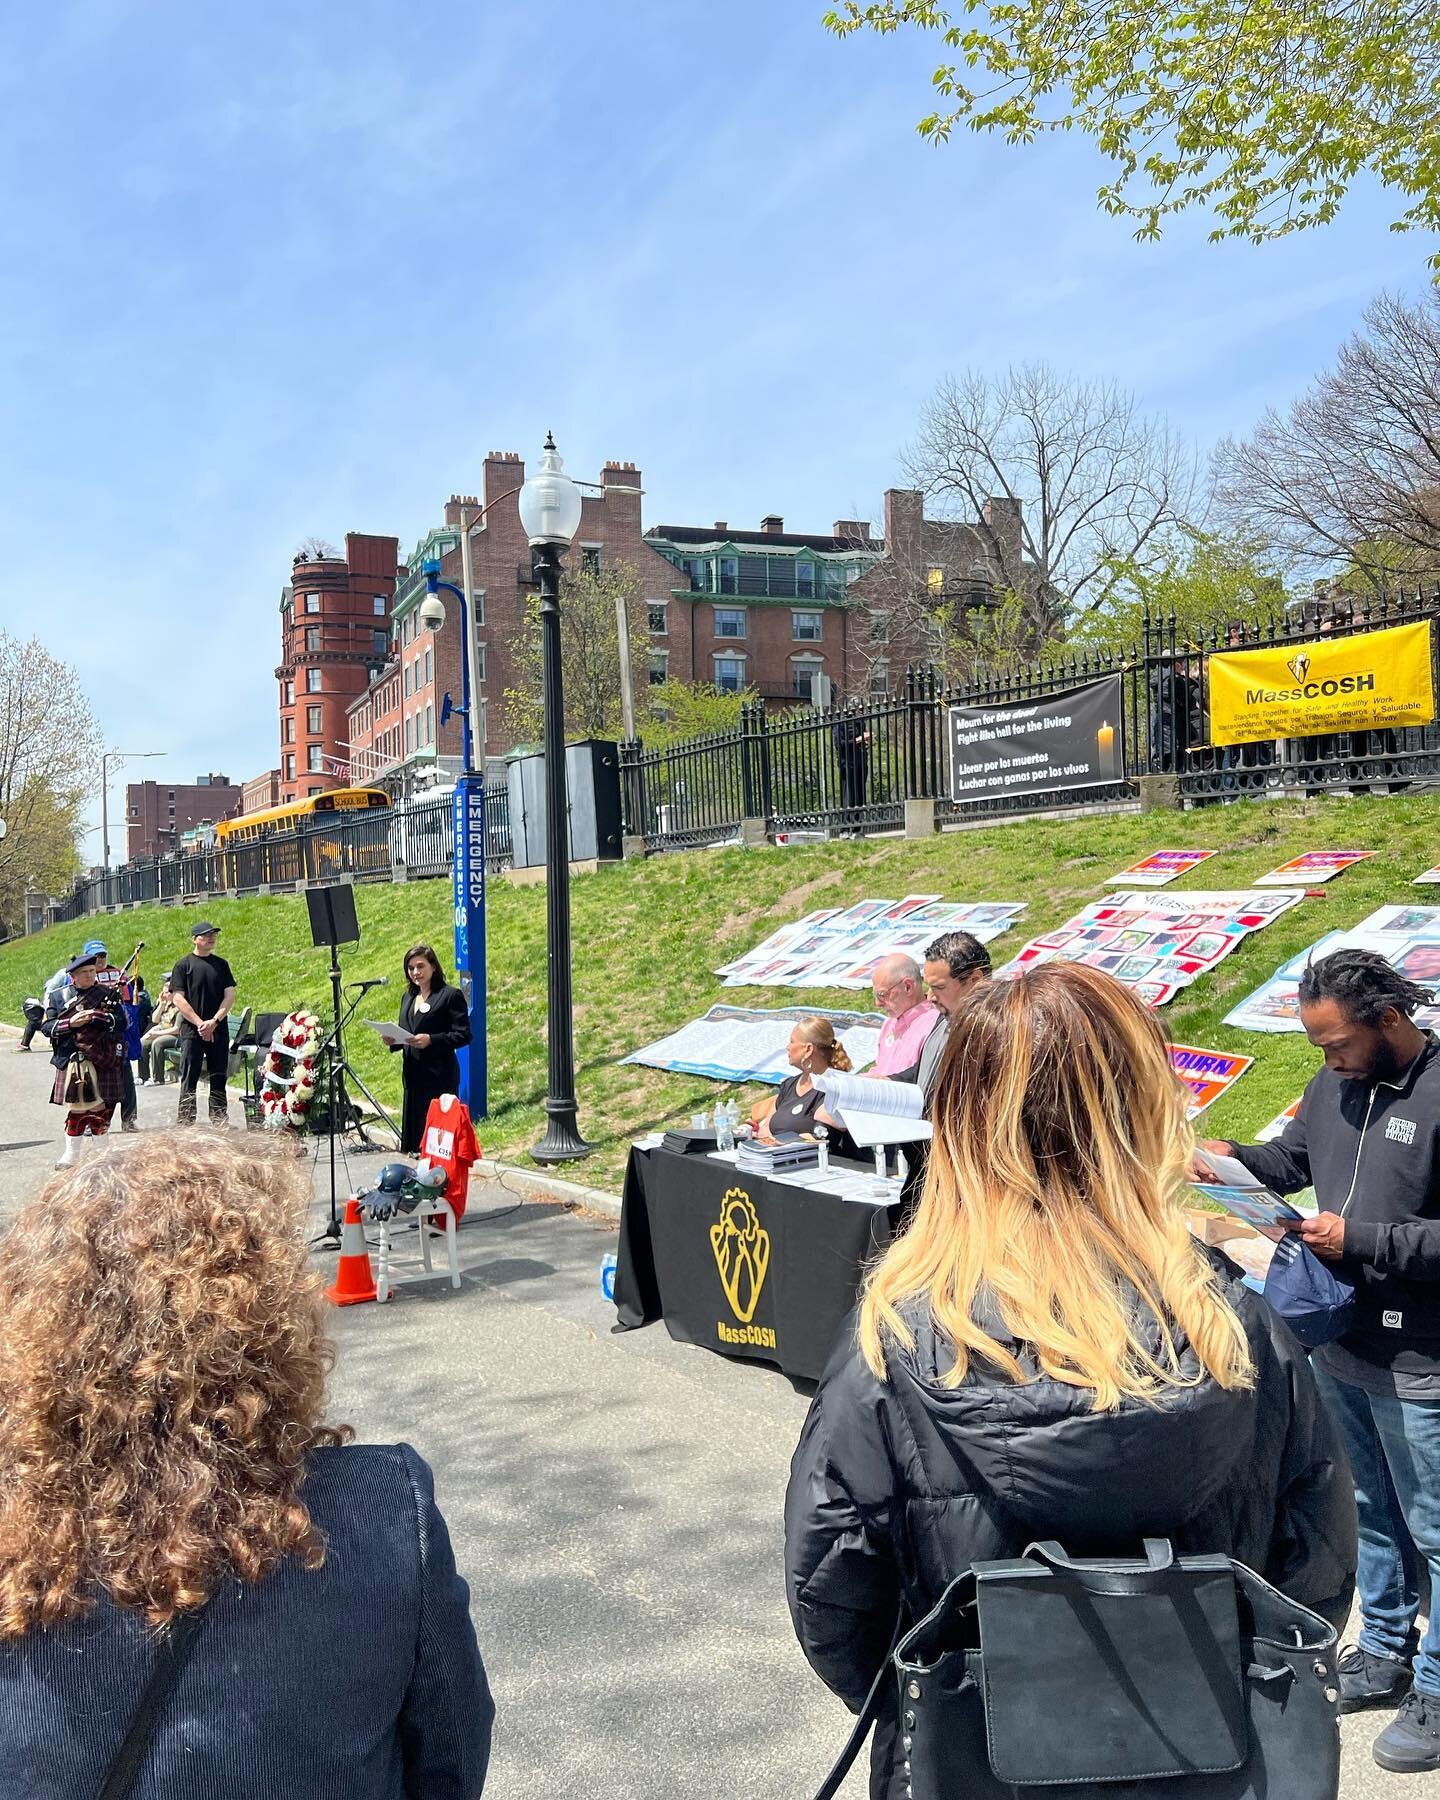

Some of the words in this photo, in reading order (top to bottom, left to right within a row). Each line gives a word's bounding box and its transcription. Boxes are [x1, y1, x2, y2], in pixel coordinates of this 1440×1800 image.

[1246, 673, 1374, 705] MassCOSH
[956, 718, 982, 730] Mourn
[982, 713, 996, 726] for
[996, 711, 1012, 722] the
[1234, 711, 1259, 721] Standing
[1262, 708, 1289, 718] Together
[1342, 699, 1368, 708] Healthy
[1305, 713, 1334, 722] Trabajos
[1337, 709, 1368, 720] Seguros
[1381, 702, 1424, 713] Saludable.
[1355, 716, 1369, 724] nan
[957, 731, 979, 746] Fight
[979, 729, 996, 742] like
[996, 725, 1012, 738] hell
[1012, 722, 1026, 735] for
[1027, 720, 1042, 732] the
[1043, 715, 1072, 729] living
[959, 762, 983, 775] Llorar
[984, 760, 999, 773] por
[1000, 757, 1011, 769] los
[1012, 752, 1049, 766] muertos
[959, 777, 987, 790] Luchar
[987, 775, 1004, 786] con
[1004, 773, 1031, 786] ganas
[1031, 769, 1048, 782] por
[1049, 766, 1062, 778] los
[1063, 763, 1090, 776] vivos
[456, 795, 464, 908] EMERGENCY
[468, 794, 482, 908] EMERGENCY
[455, 906, 467, 928] 06
[1174, 1051, 1235, 1075] OURN
[1385, 1128, 1413, 1145] UNIONS
[717, 1321, 776, 1349] MassCOSH
